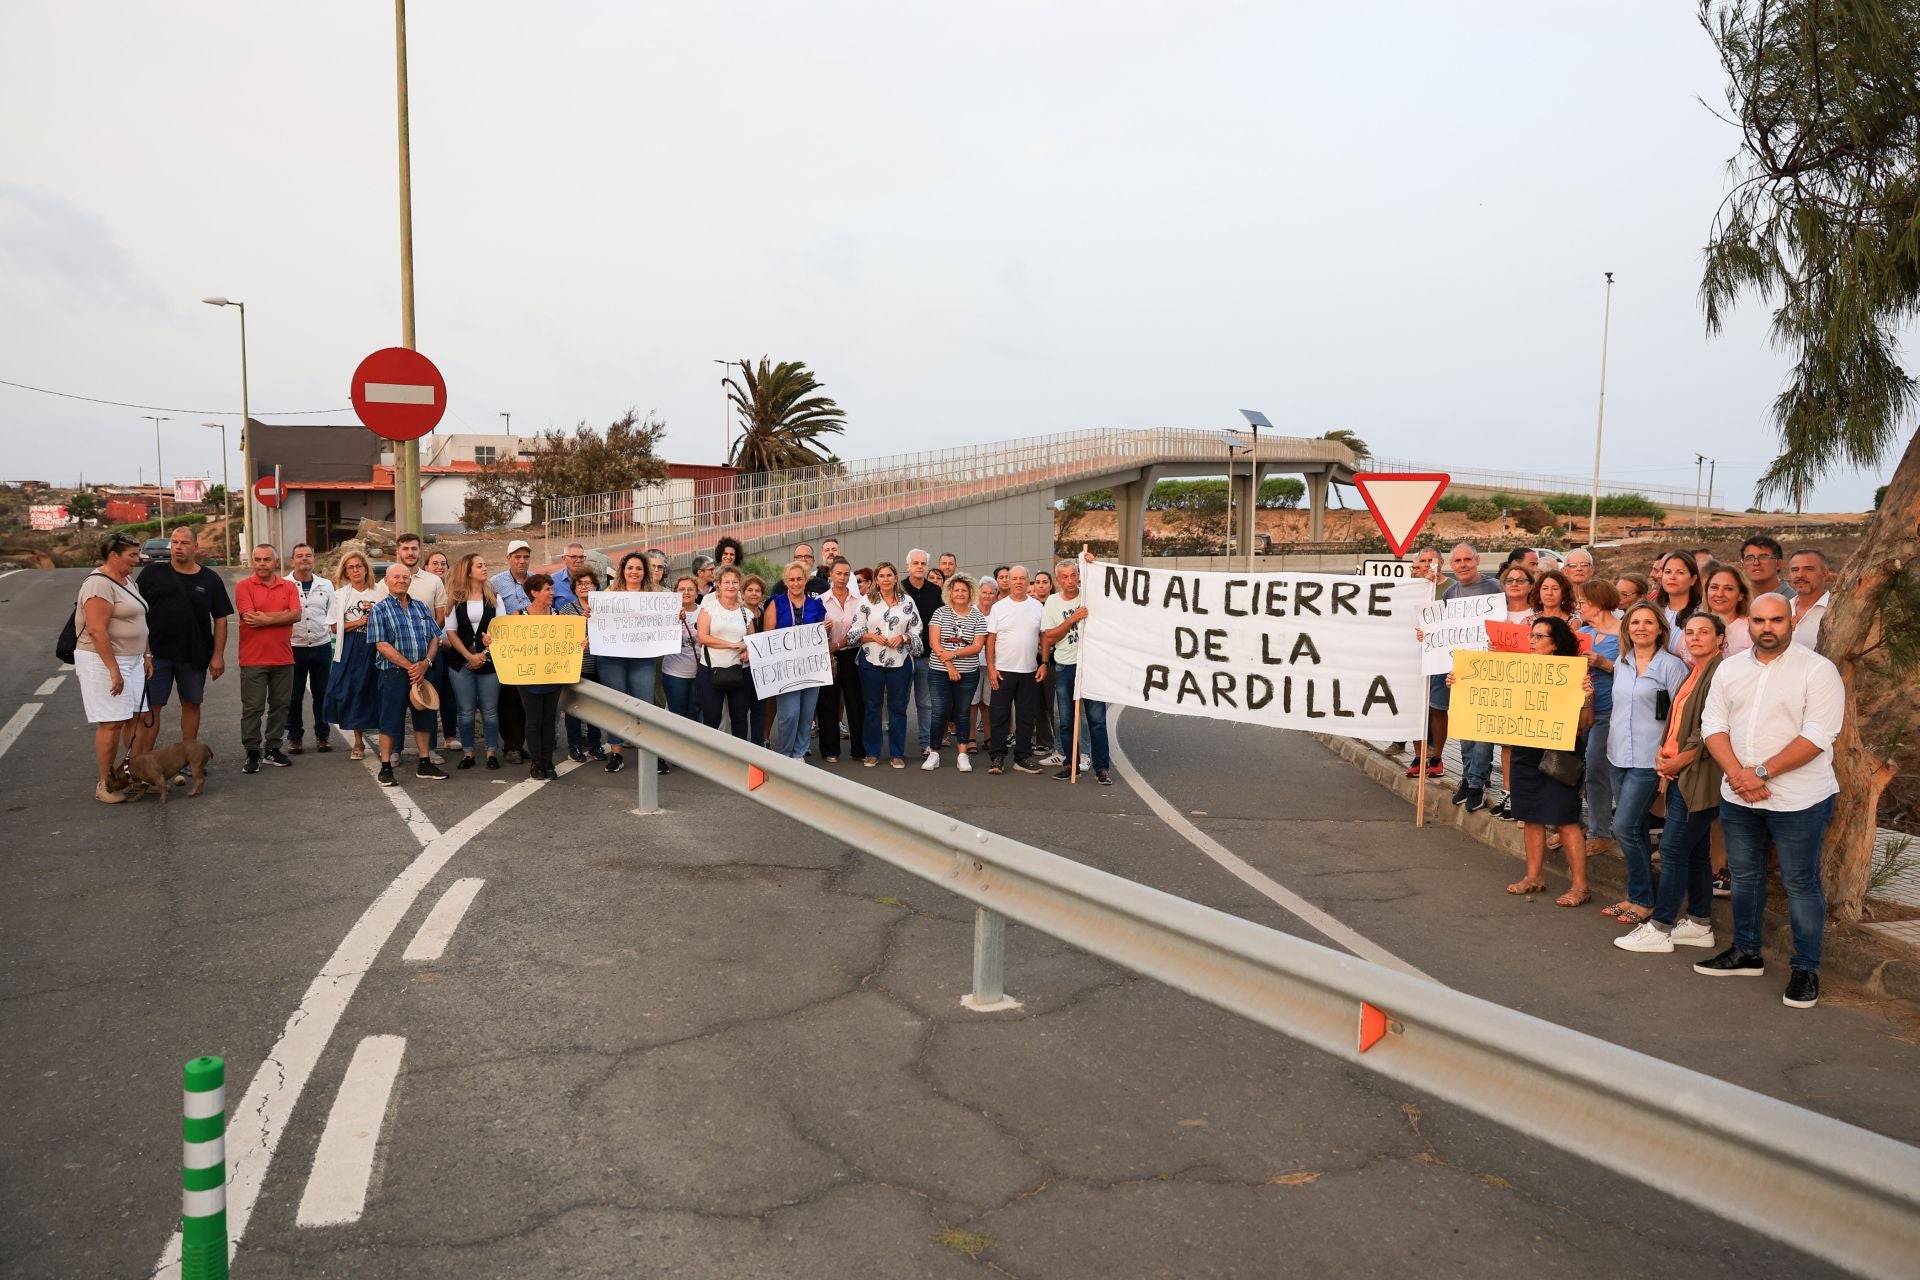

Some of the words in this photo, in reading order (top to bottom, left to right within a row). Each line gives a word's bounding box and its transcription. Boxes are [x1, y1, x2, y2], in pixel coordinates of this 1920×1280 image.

[1373, 564, 1404, 577] 100
[1104, 566, 1150, 606] NO
[1163, 575, 1209, 615] AL
[1224, 579, 1396, 617] CIERRE
[1175, 626, 1230, 663] DE
[1261, 632, 1322, 665] LA
[1424, 626, 1489, 652] SOLUCIONE
[517, 663, 536, 676] LA
[1461, 659, 1570, 686] SOLUCIONES
[1143, 664, 1399, 719] PARDILLA
[1469, 686, 1512, 708] PARA
[1525, 690, 1549, 711] LA
[1476, 713, 1564, 740] PARDILLA
